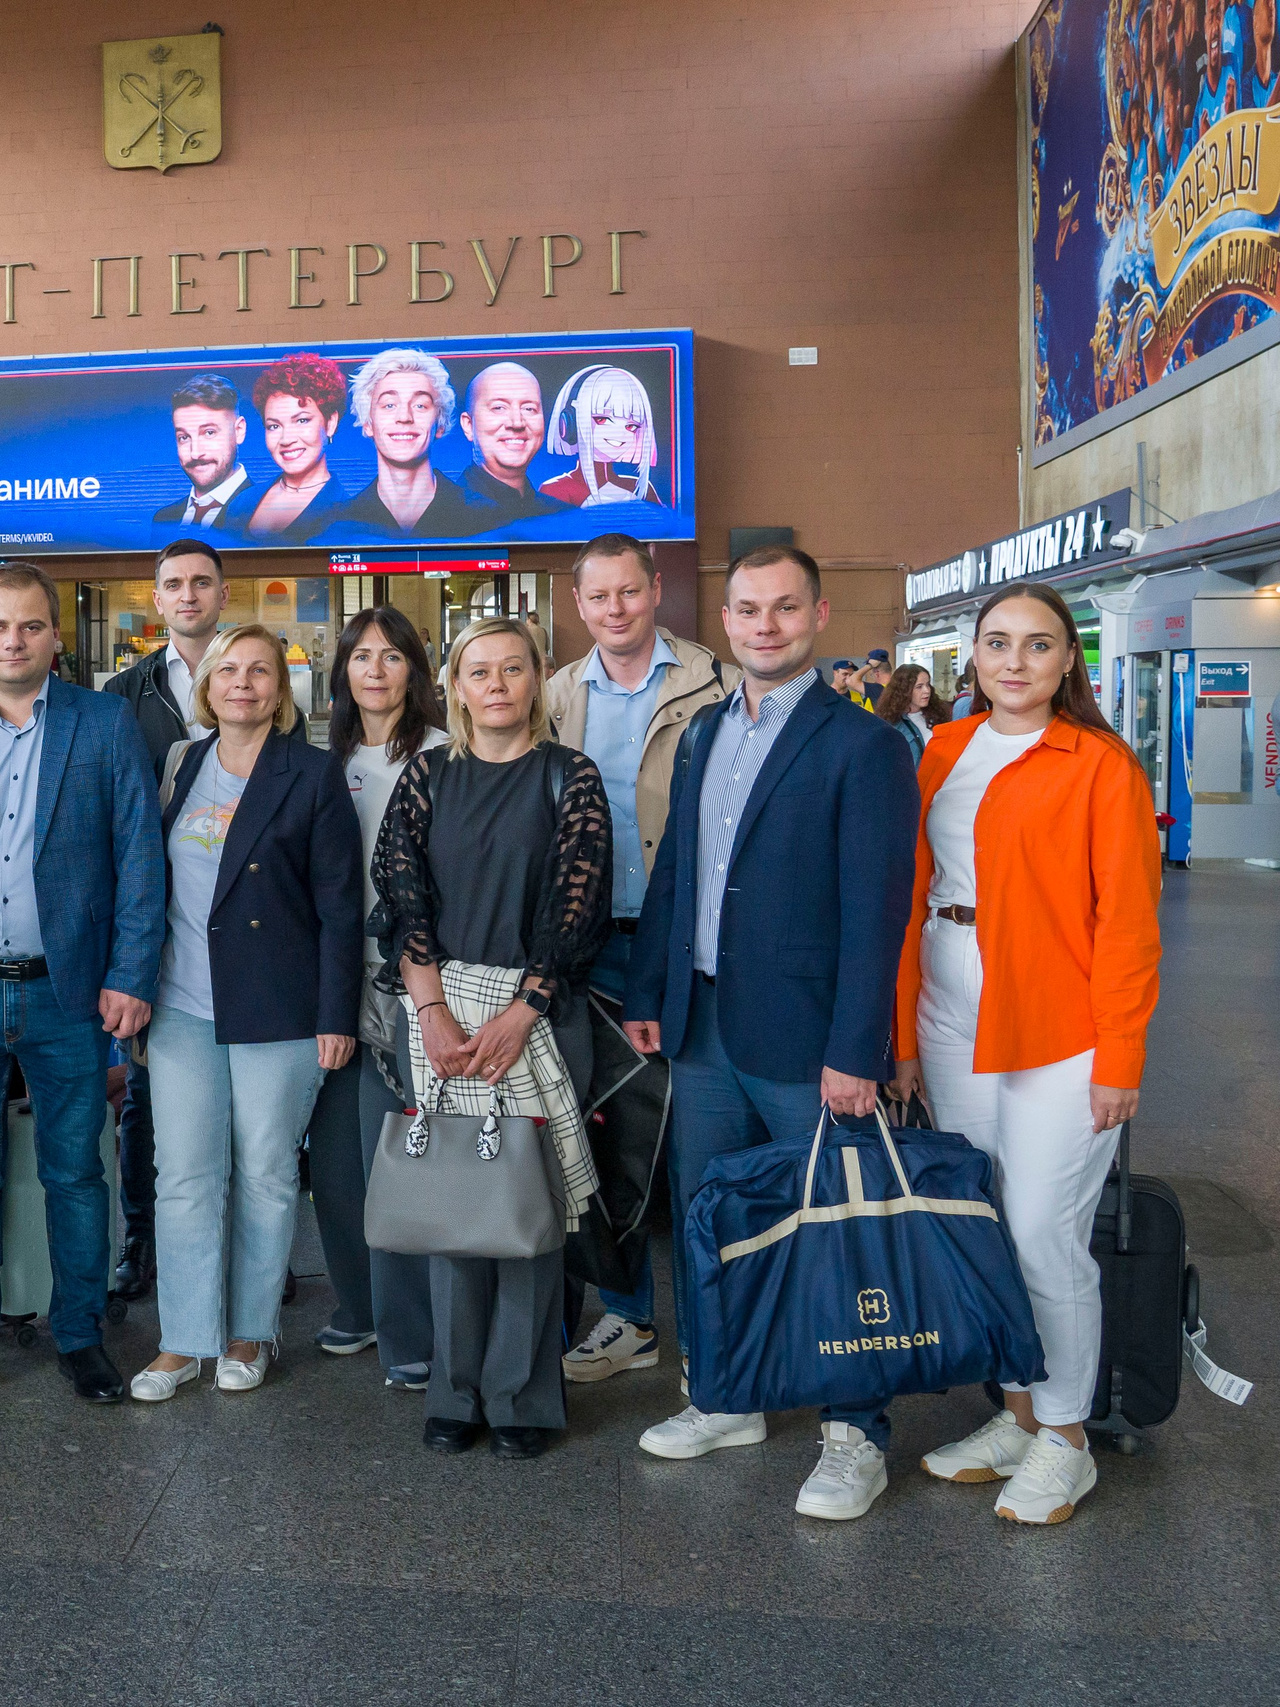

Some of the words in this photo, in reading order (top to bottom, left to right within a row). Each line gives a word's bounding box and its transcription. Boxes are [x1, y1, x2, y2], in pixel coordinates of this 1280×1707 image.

[1169, 121, 1262, 258] ЗВЁЗДЫ
[989, 519, 1062, 585] ПРОДУКТЫ
[1063, 510, 1087, 564] 24
[913, 562, 949, 604] СТОЛОВАЯ
[1165, 616, 1186, 630] DRINKS
[1201, 666, 1233, 676] Выход
[1201, 678, 1215, 686] Exit
[818, 1330, 940, 1355] HENDERSON
